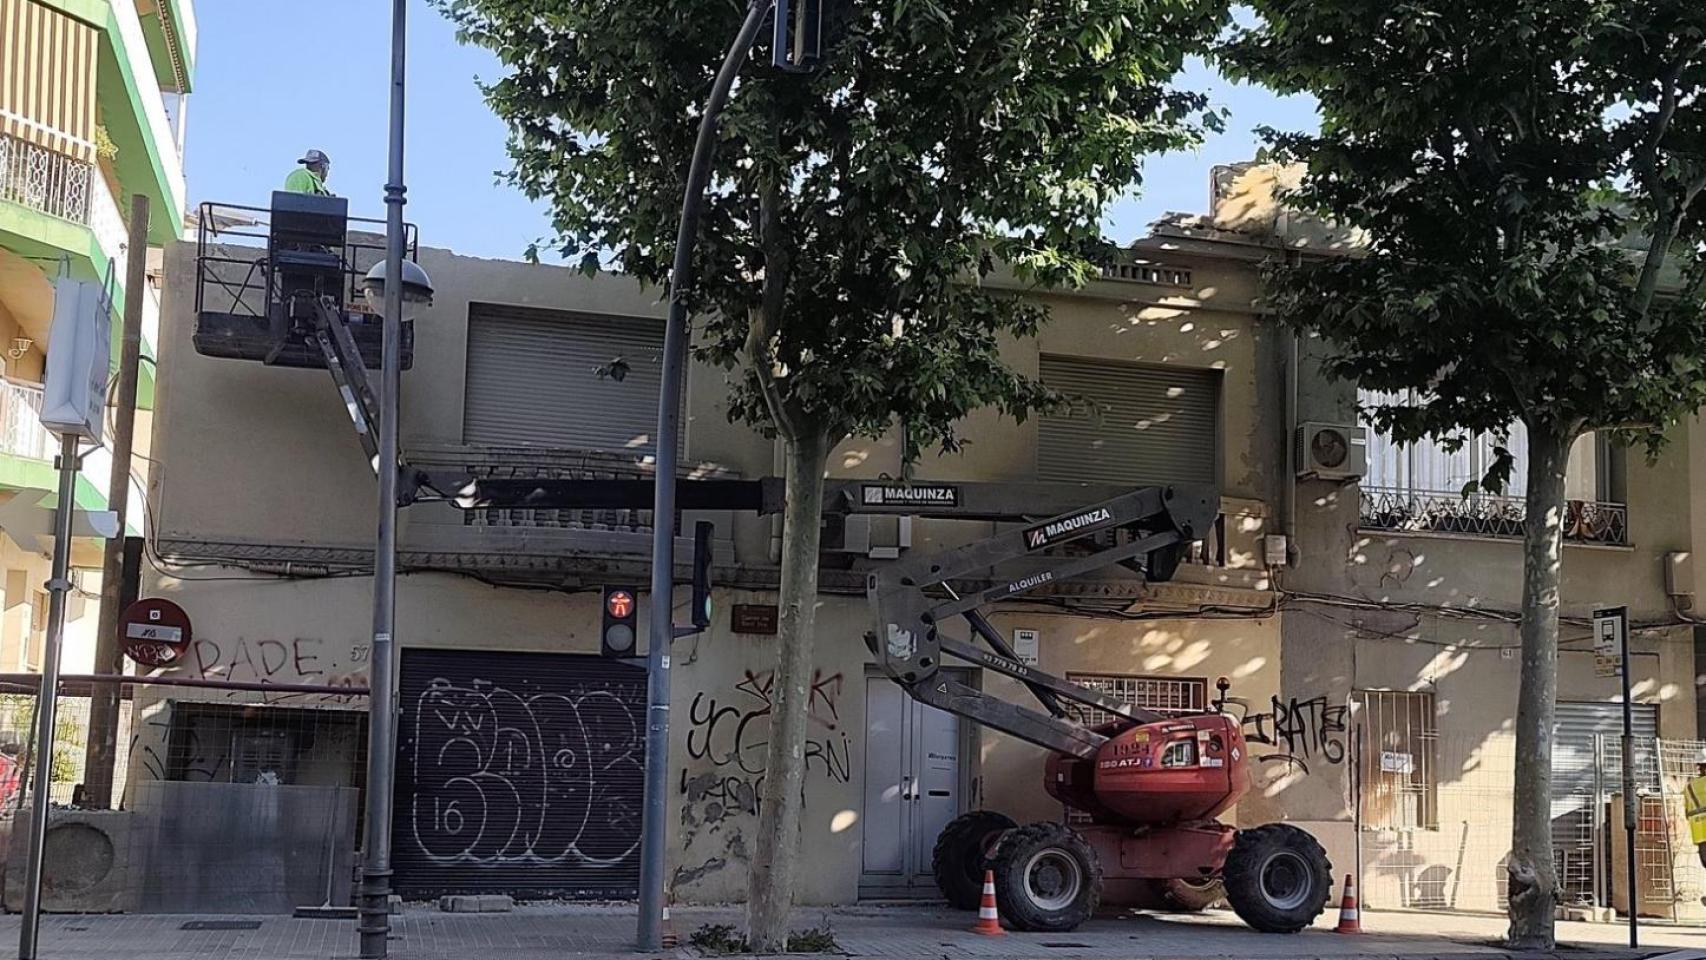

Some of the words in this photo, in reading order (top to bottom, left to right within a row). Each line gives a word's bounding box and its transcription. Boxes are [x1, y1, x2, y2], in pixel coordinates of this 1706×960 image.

[885, 487, 954, 500] MAQUINZA
[1045, 508, 1110, 537] MAQUINZA
[1009, 571, 1053, 593] ALQUILER
[1118, 758, 1141, 767] ATJ
